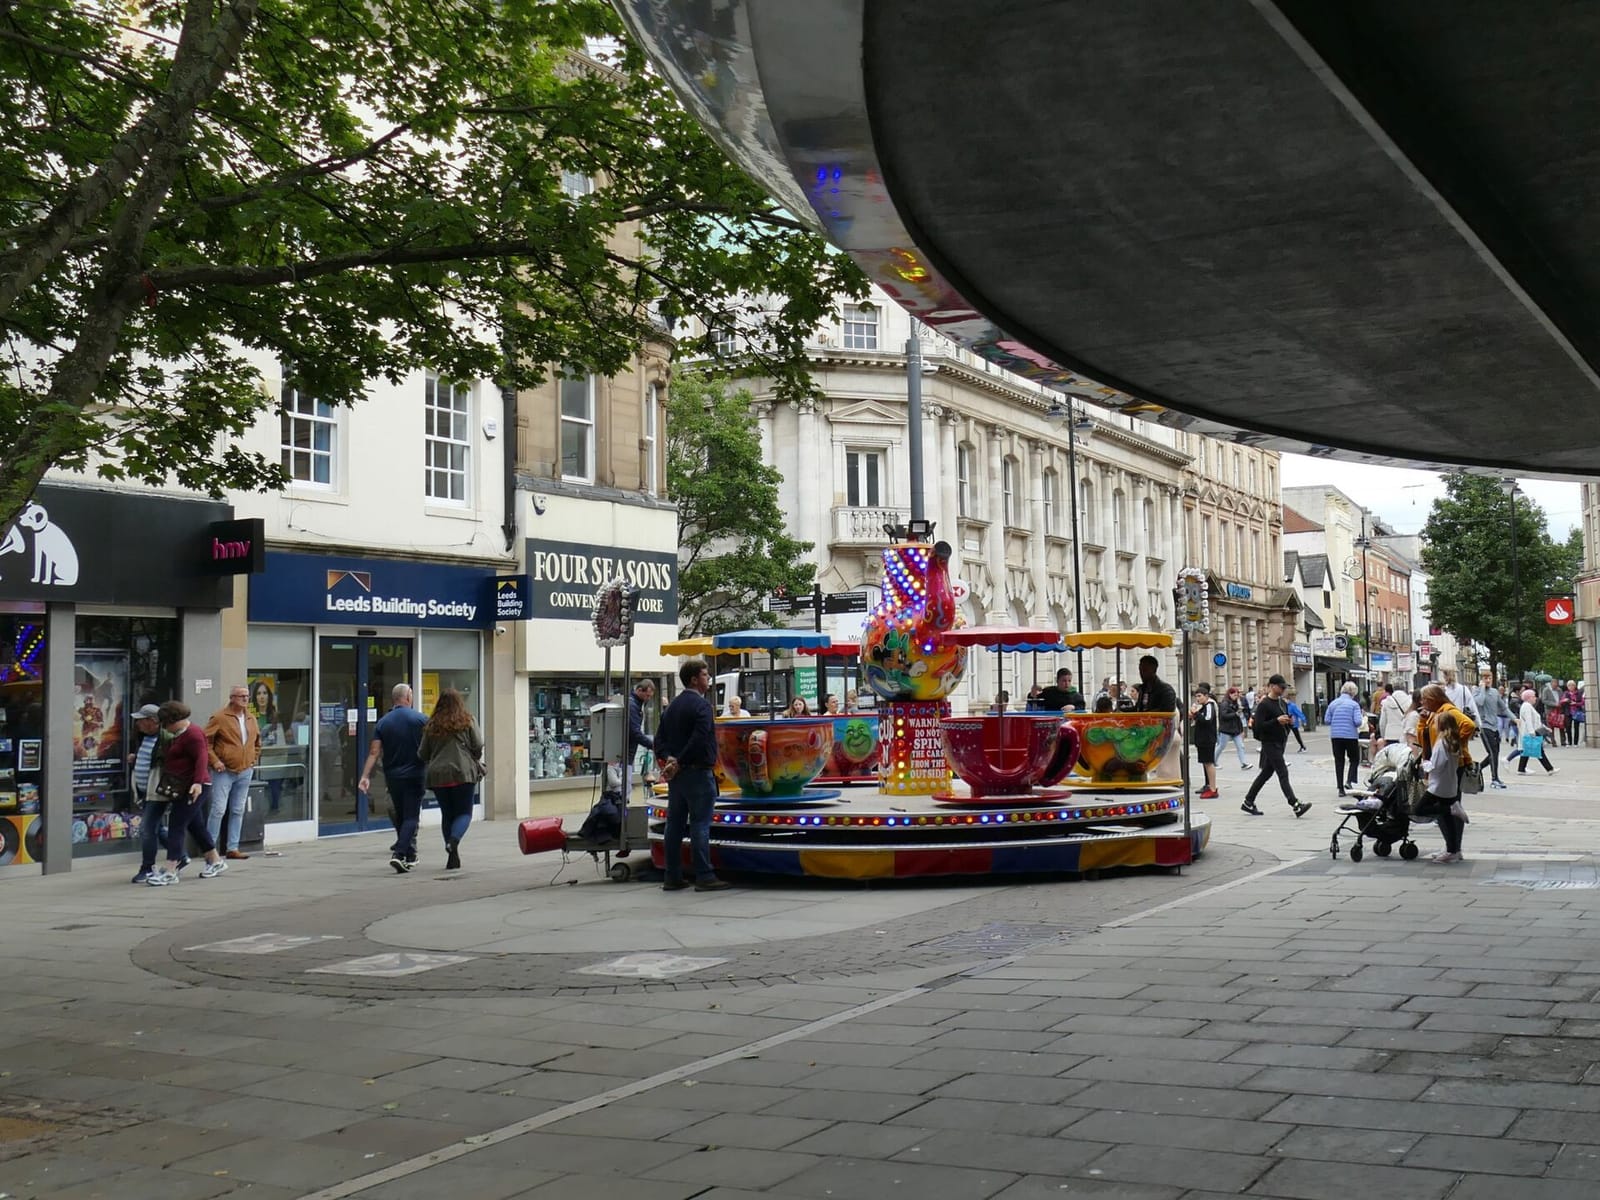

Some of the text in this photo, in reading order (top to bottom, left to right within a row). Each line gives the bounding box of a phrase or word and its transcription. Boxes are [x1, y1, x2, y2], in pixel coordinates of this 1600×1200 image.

[212, 537, 251, 560] hmv
[534, 551, 672, 591] FOUR SEASONS
[497, 591, 517, 600] Leeds
[326, 593, 477, 621] Leeds Building Society
[497, 599, 523, 609] Building
[550, 592, 664, 613] CONVEN TORE
[497, 607, 522, 617] Society
[909, 718, 940, 728] WARNIN
[915, 729, 940, 738] DO NOT
[913, 738, 942, 750] SPIN
[912, 750, 925, 758] THE
[910, 759, 946, 769] FROM THE
[910, 768, 946, 779] OUTSIDE
